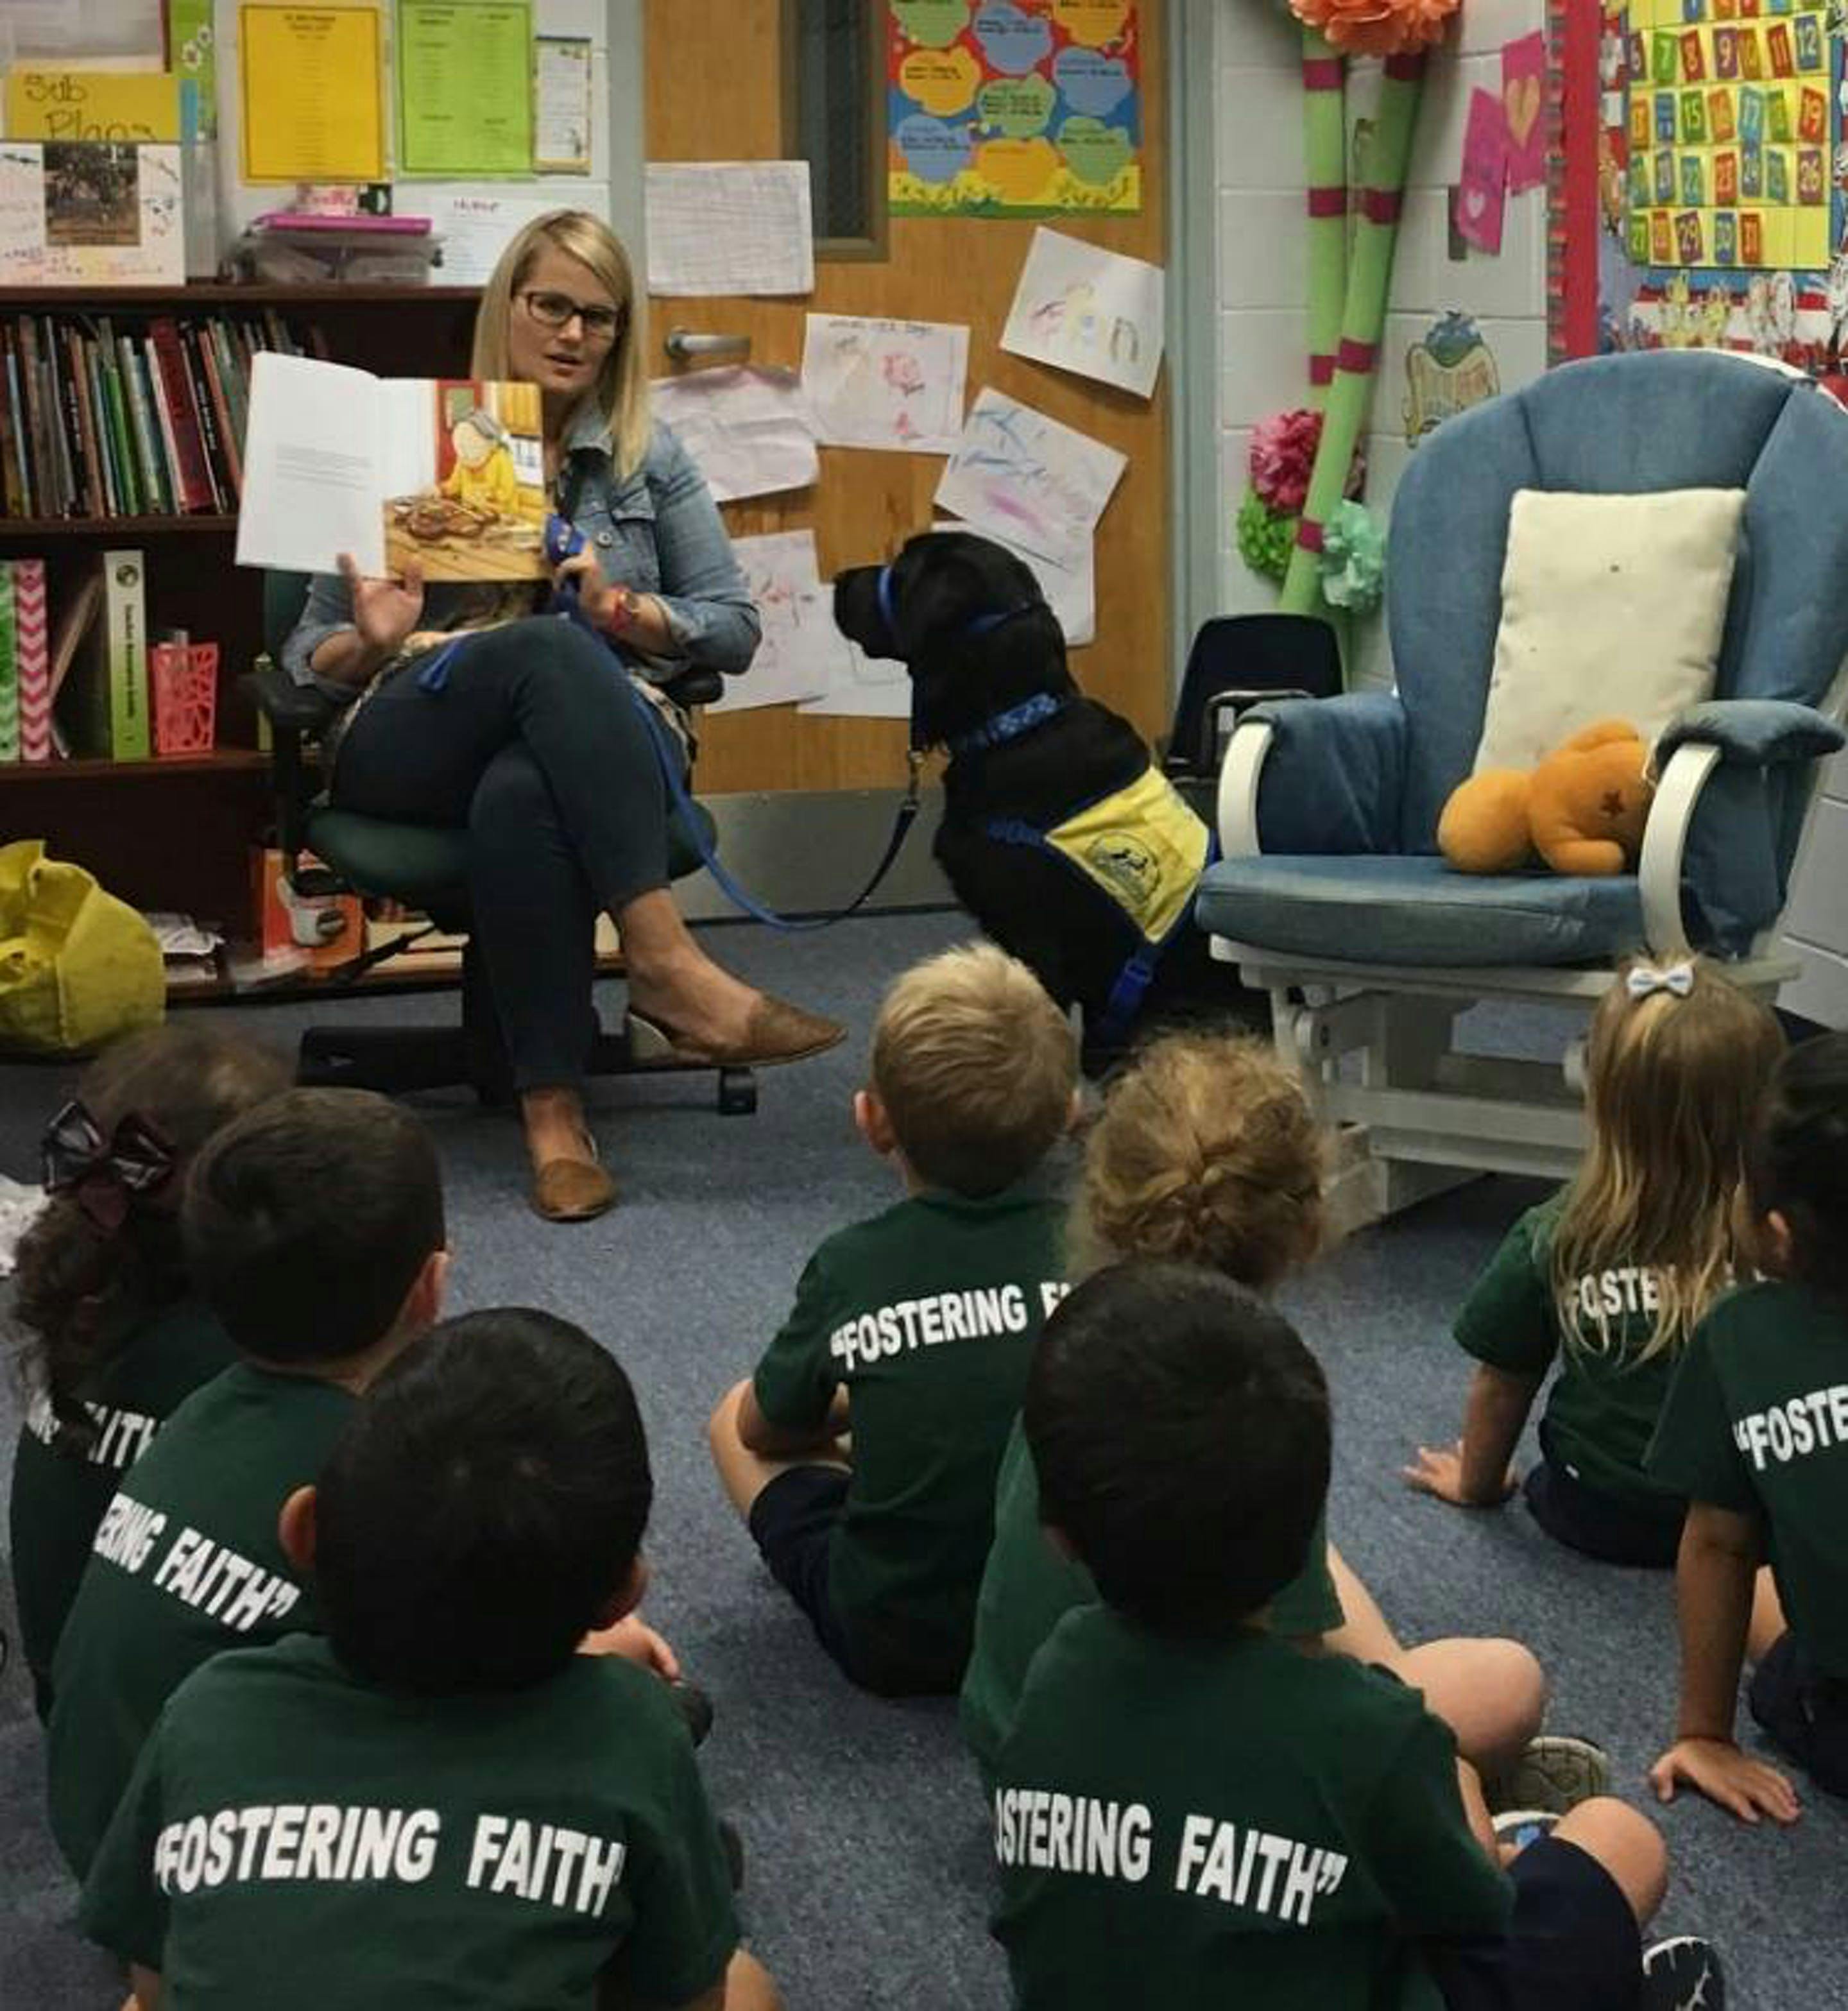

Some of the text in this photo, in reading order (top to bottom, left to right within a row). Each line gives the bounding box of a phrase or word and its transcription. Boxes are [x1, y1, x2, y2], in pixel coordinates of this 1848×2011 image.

[1718, 35, 1732, 69] 9
[1799, 23, 1817, 56] 12
[24, 74, 88, 103] Sub
[1684, 98, 1701, 132] 15
[1801, 159, 1821, 193] 26
[1679, 218, 1699, 252] 29
[151, 1527, 302, 1631] FAITH"
[1174, 1814, 1348, 1926] FAITH"
